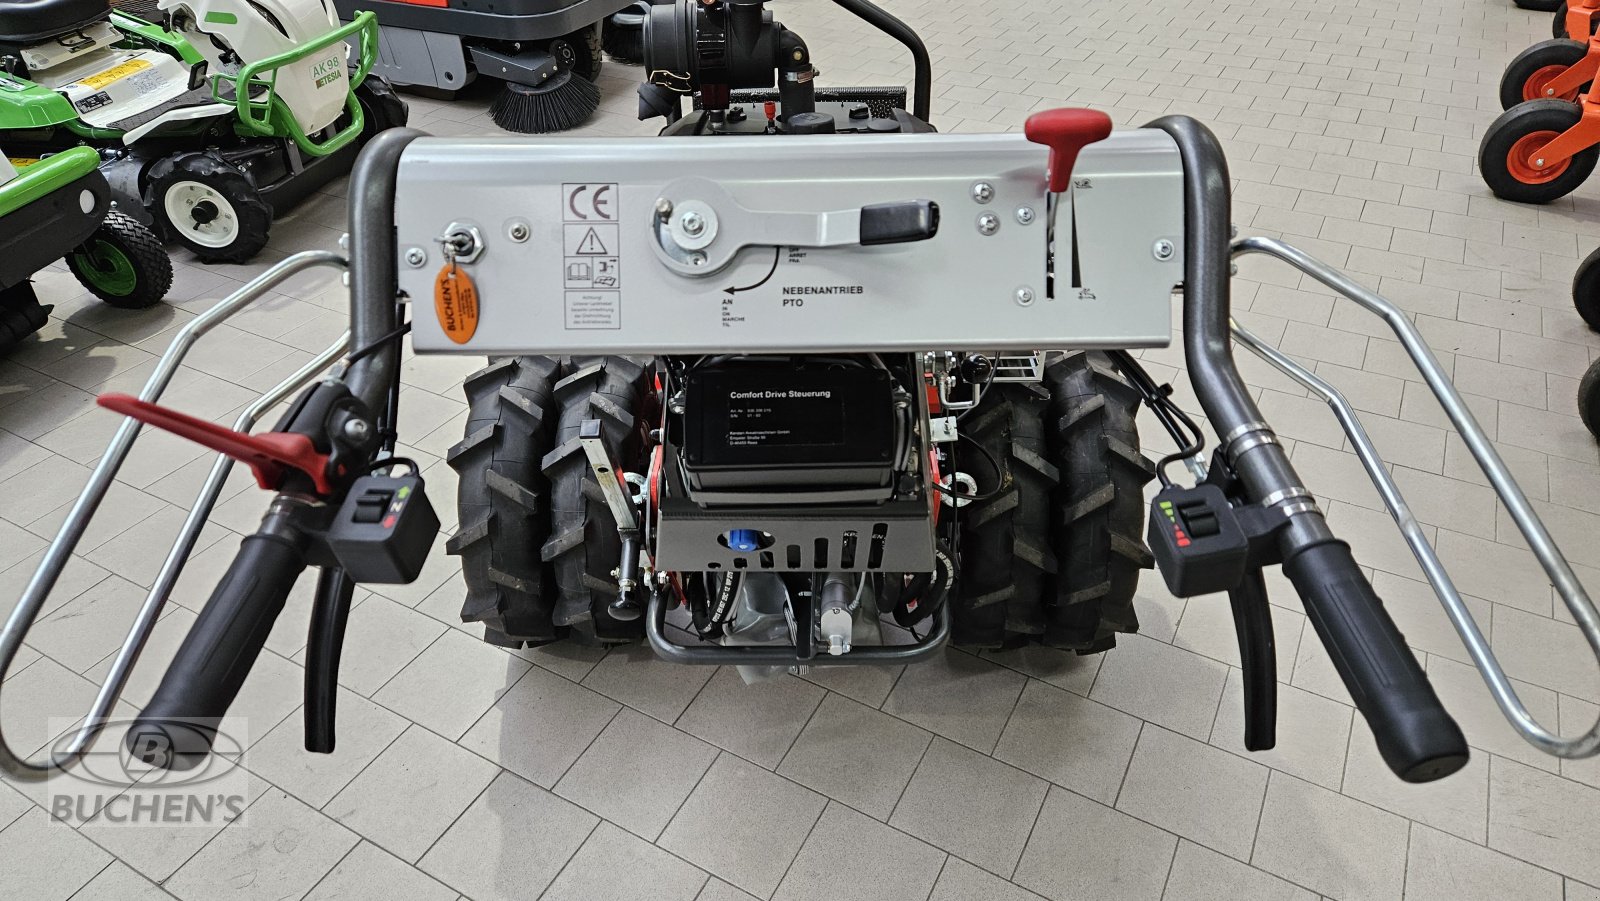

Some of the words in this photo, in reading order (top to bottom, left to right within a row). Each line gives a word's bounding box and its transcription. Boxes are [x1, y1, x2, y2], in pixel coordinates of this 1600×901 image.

[313, 62, 327, 78] AK
[327, 56, 339, 70] 98
[569, 185, 610, 220] CE
[782, 286, 864, 295] NEBENANTRIEB
[440, 278, 456, 331] BUCHEN'S
[782, 298, 804, 307] PTO
[730, 390, 763, 399] Comfort
[765, 390, 787, 398] Drive
[788, 390, 831, 399] Steuerung
[389, 502, 403, 512] N
